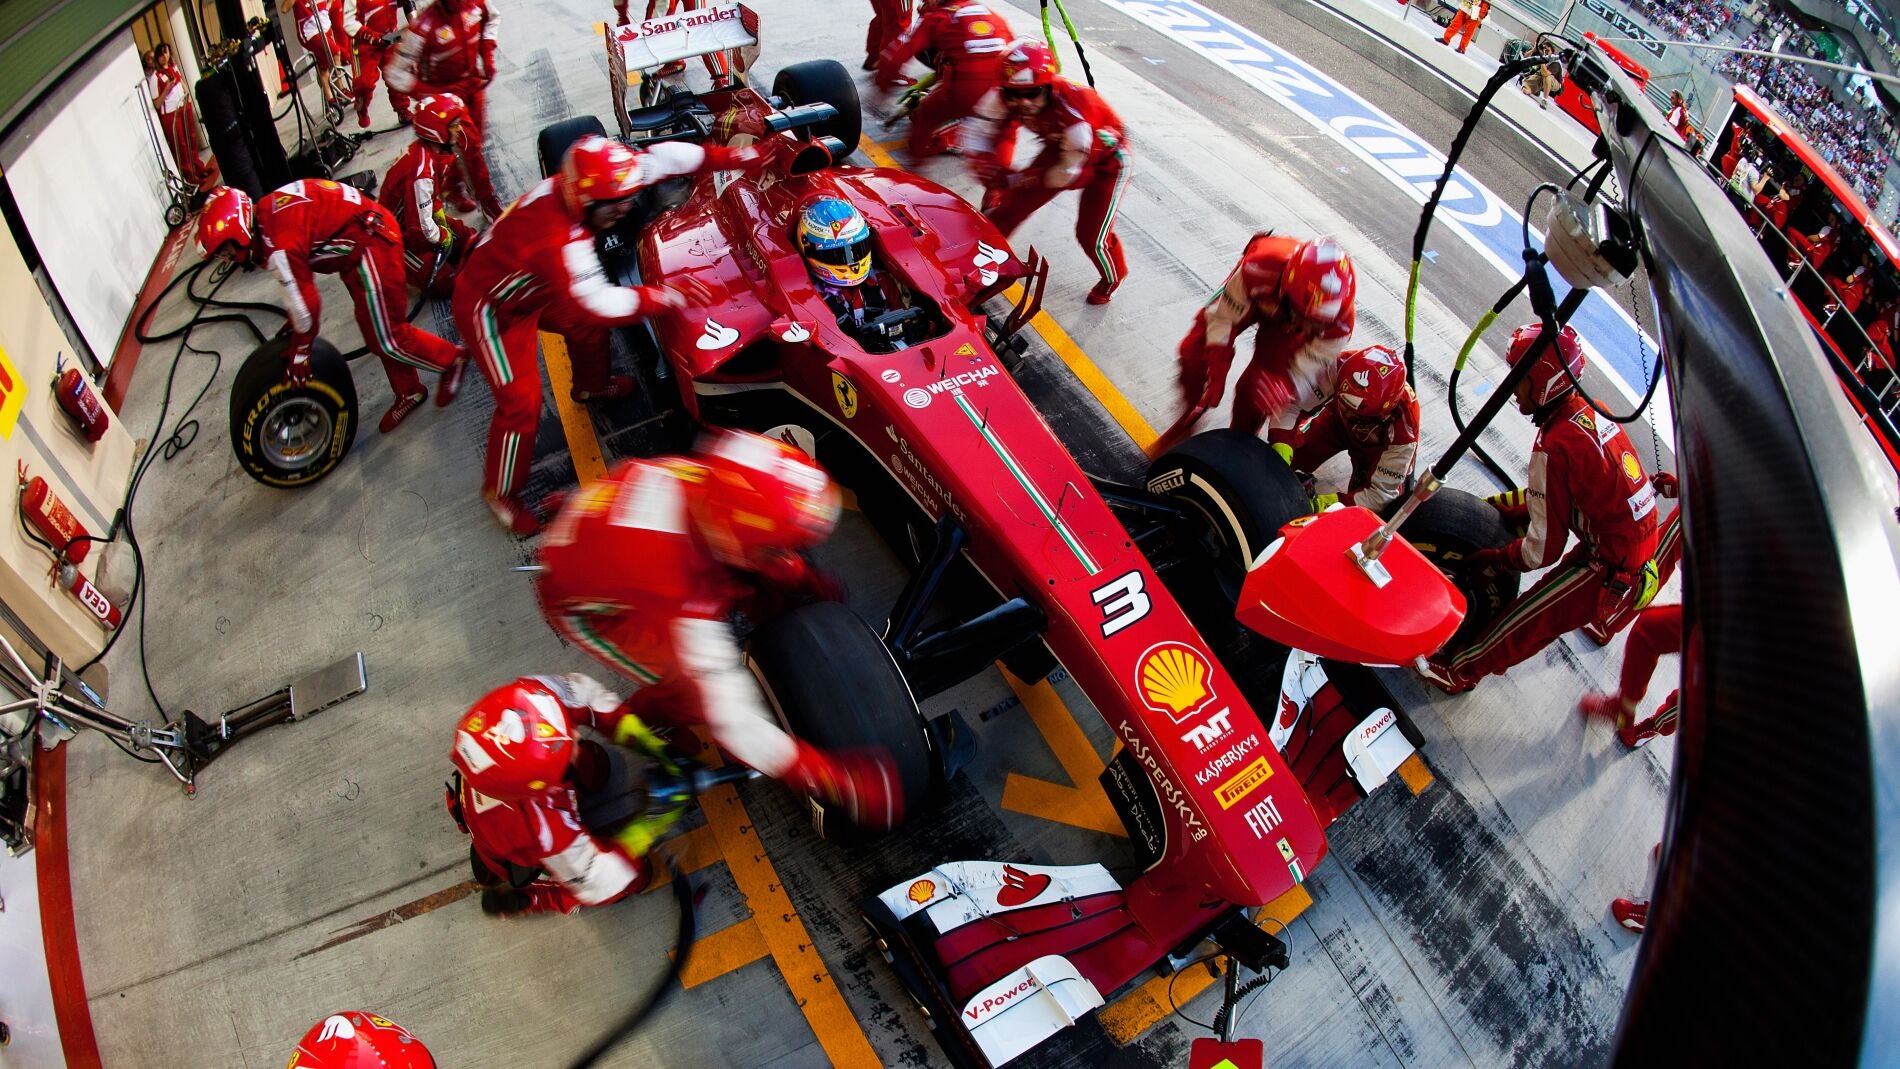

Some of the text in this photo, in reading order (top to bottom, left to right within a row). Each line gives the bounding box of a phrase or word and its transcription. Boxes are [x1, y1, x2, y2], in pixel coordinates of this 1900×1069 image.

[640, 7, 737, 37] Sanander
[1586, 0, 1659, 51] ETIHAD
[746, 239, 768, 273] HUBLOT
[926, 364, 999, 394] WEICHAI
[242, 392, 270, 456] ZERO
[900, 437, 967, 522] Santander
[903, 466, 938, 512] WEICHAI
[85, 585, 108, 614] CEA
[1089, 568, 1153, 640] 3
[1180, 706, 1232, 751] TNT
[1119, 720, 1208, 843] KASPERSKY lab
[1195, 736, 1253, 786] KASPERSKY
[1220, 763, 1268, 804] PIRELLI
[1109, 767, 1157, 855] Abu Dhabi
[1243, 794, 1283, 840] FIAT
[965, 977, 1034, 1020] V-Power
